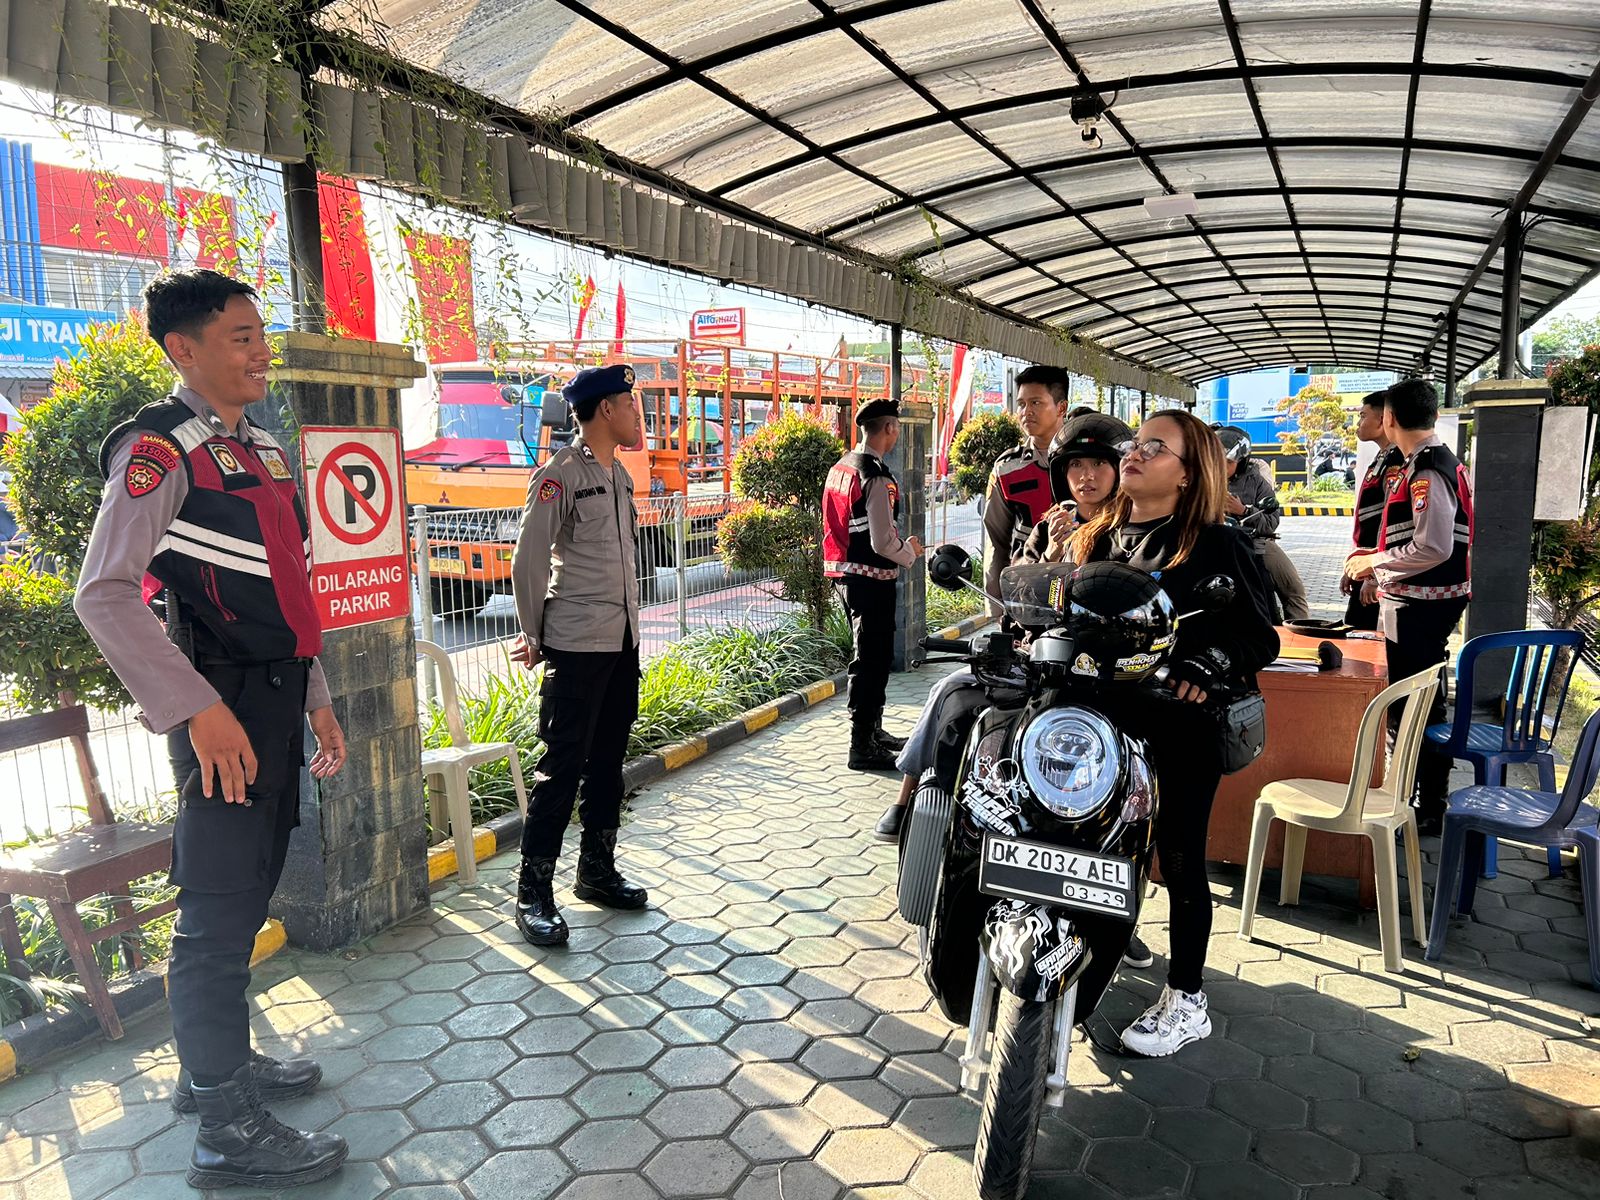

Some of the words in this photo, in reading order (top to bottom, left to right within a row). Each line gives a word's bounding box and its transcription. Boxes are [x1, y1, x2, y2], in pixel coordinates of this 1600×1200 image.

[26, 319, 96, 345] TRAN
[697, 313, 738, 325] Alfamart
[149, 447, 175, 469] SQUAD
[317, 565, 403, 594] DILARANG
[330, 591, 391, 618] PARKIR
[992, 841, 1020, 864] DK
[1026, 848, 1079, 877] 2034
[1086, 860, 1126, 885] AEL
